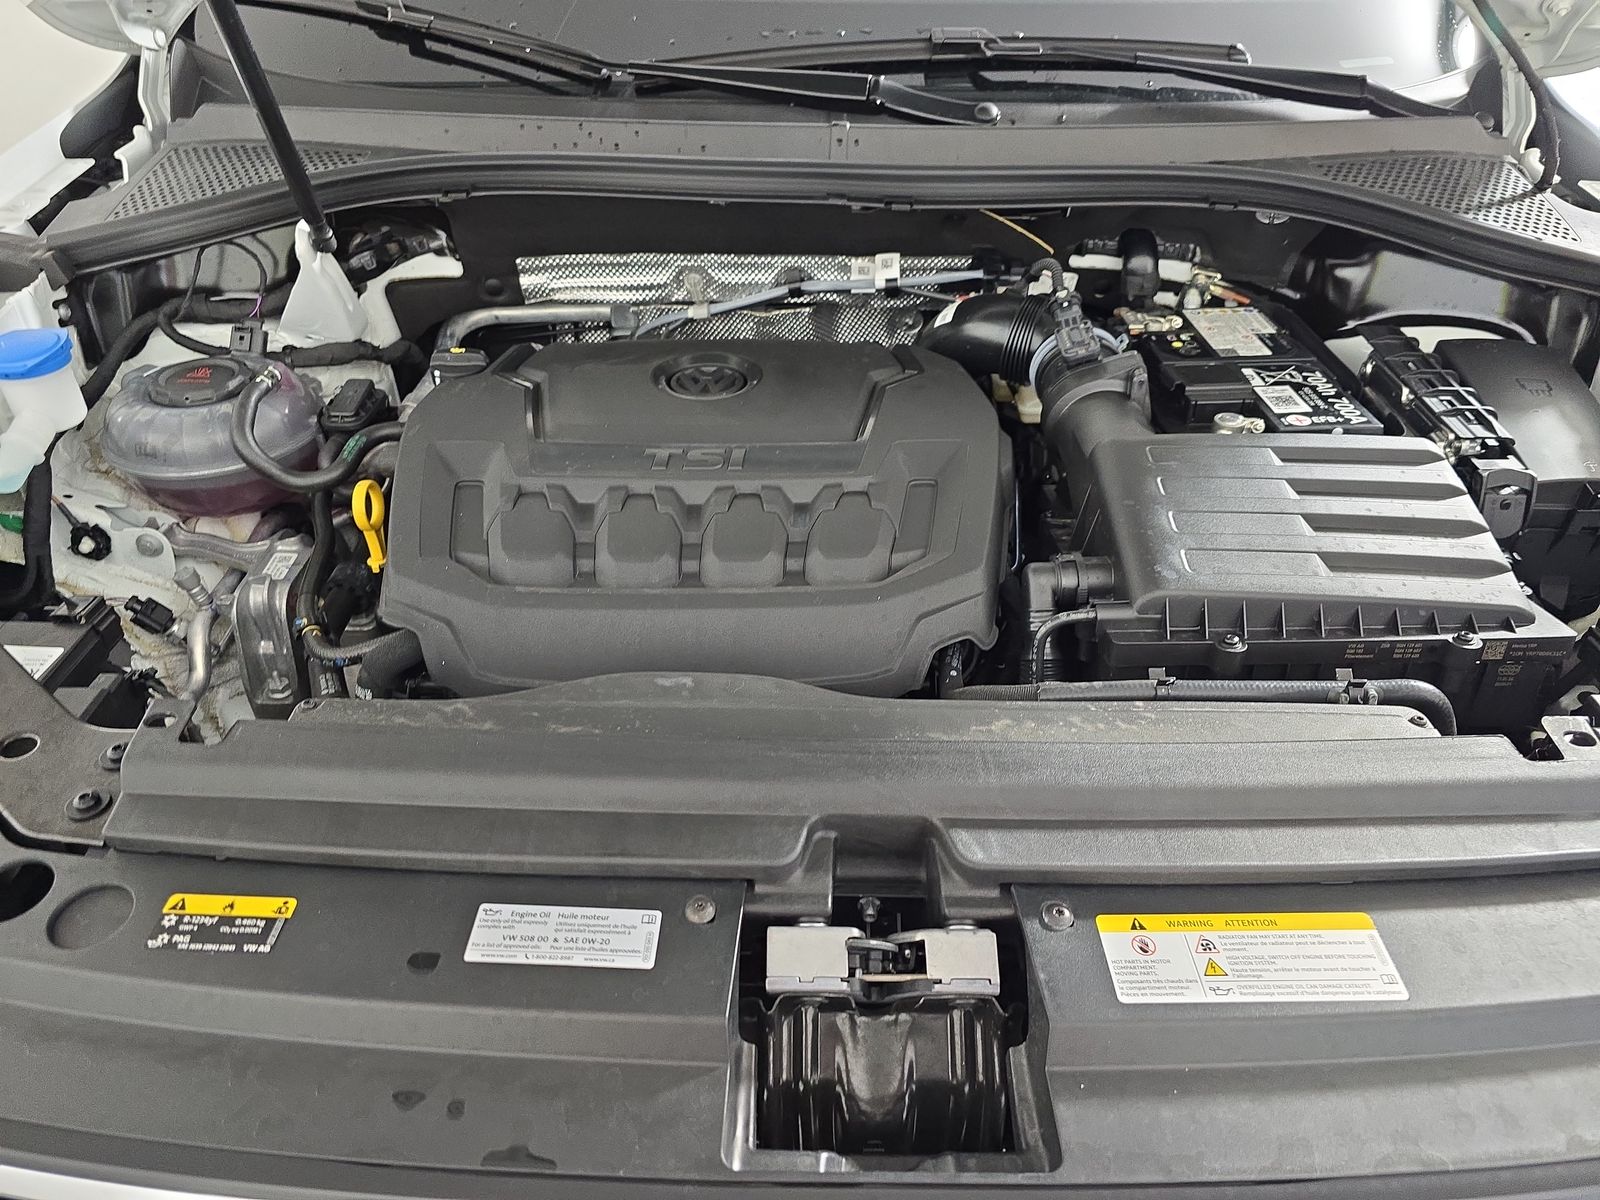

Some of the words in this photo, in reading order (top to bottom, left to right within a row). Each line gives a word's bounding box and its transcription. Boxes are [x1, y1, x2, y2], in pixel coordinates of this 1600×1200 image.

[1302, 371, 1337, 396] 70Ah
[1328, 396, 1368, 425] 700A
[644, 447, 748, 471] TSI
[511, 910, 538, 919] Engine
[558, 912, 578, 920] Huile
[1165, 919, 1213, 928] WARNING
[1224, 919, 1278, 927] ATTENTION
[172, 934, 191, 943] PAG
[519, 934, 535, 942] 508
[582, 937, 610, 945] 0W-20
[243, 944, 258, 953] VW
[258, 944, 271, 953] AG
